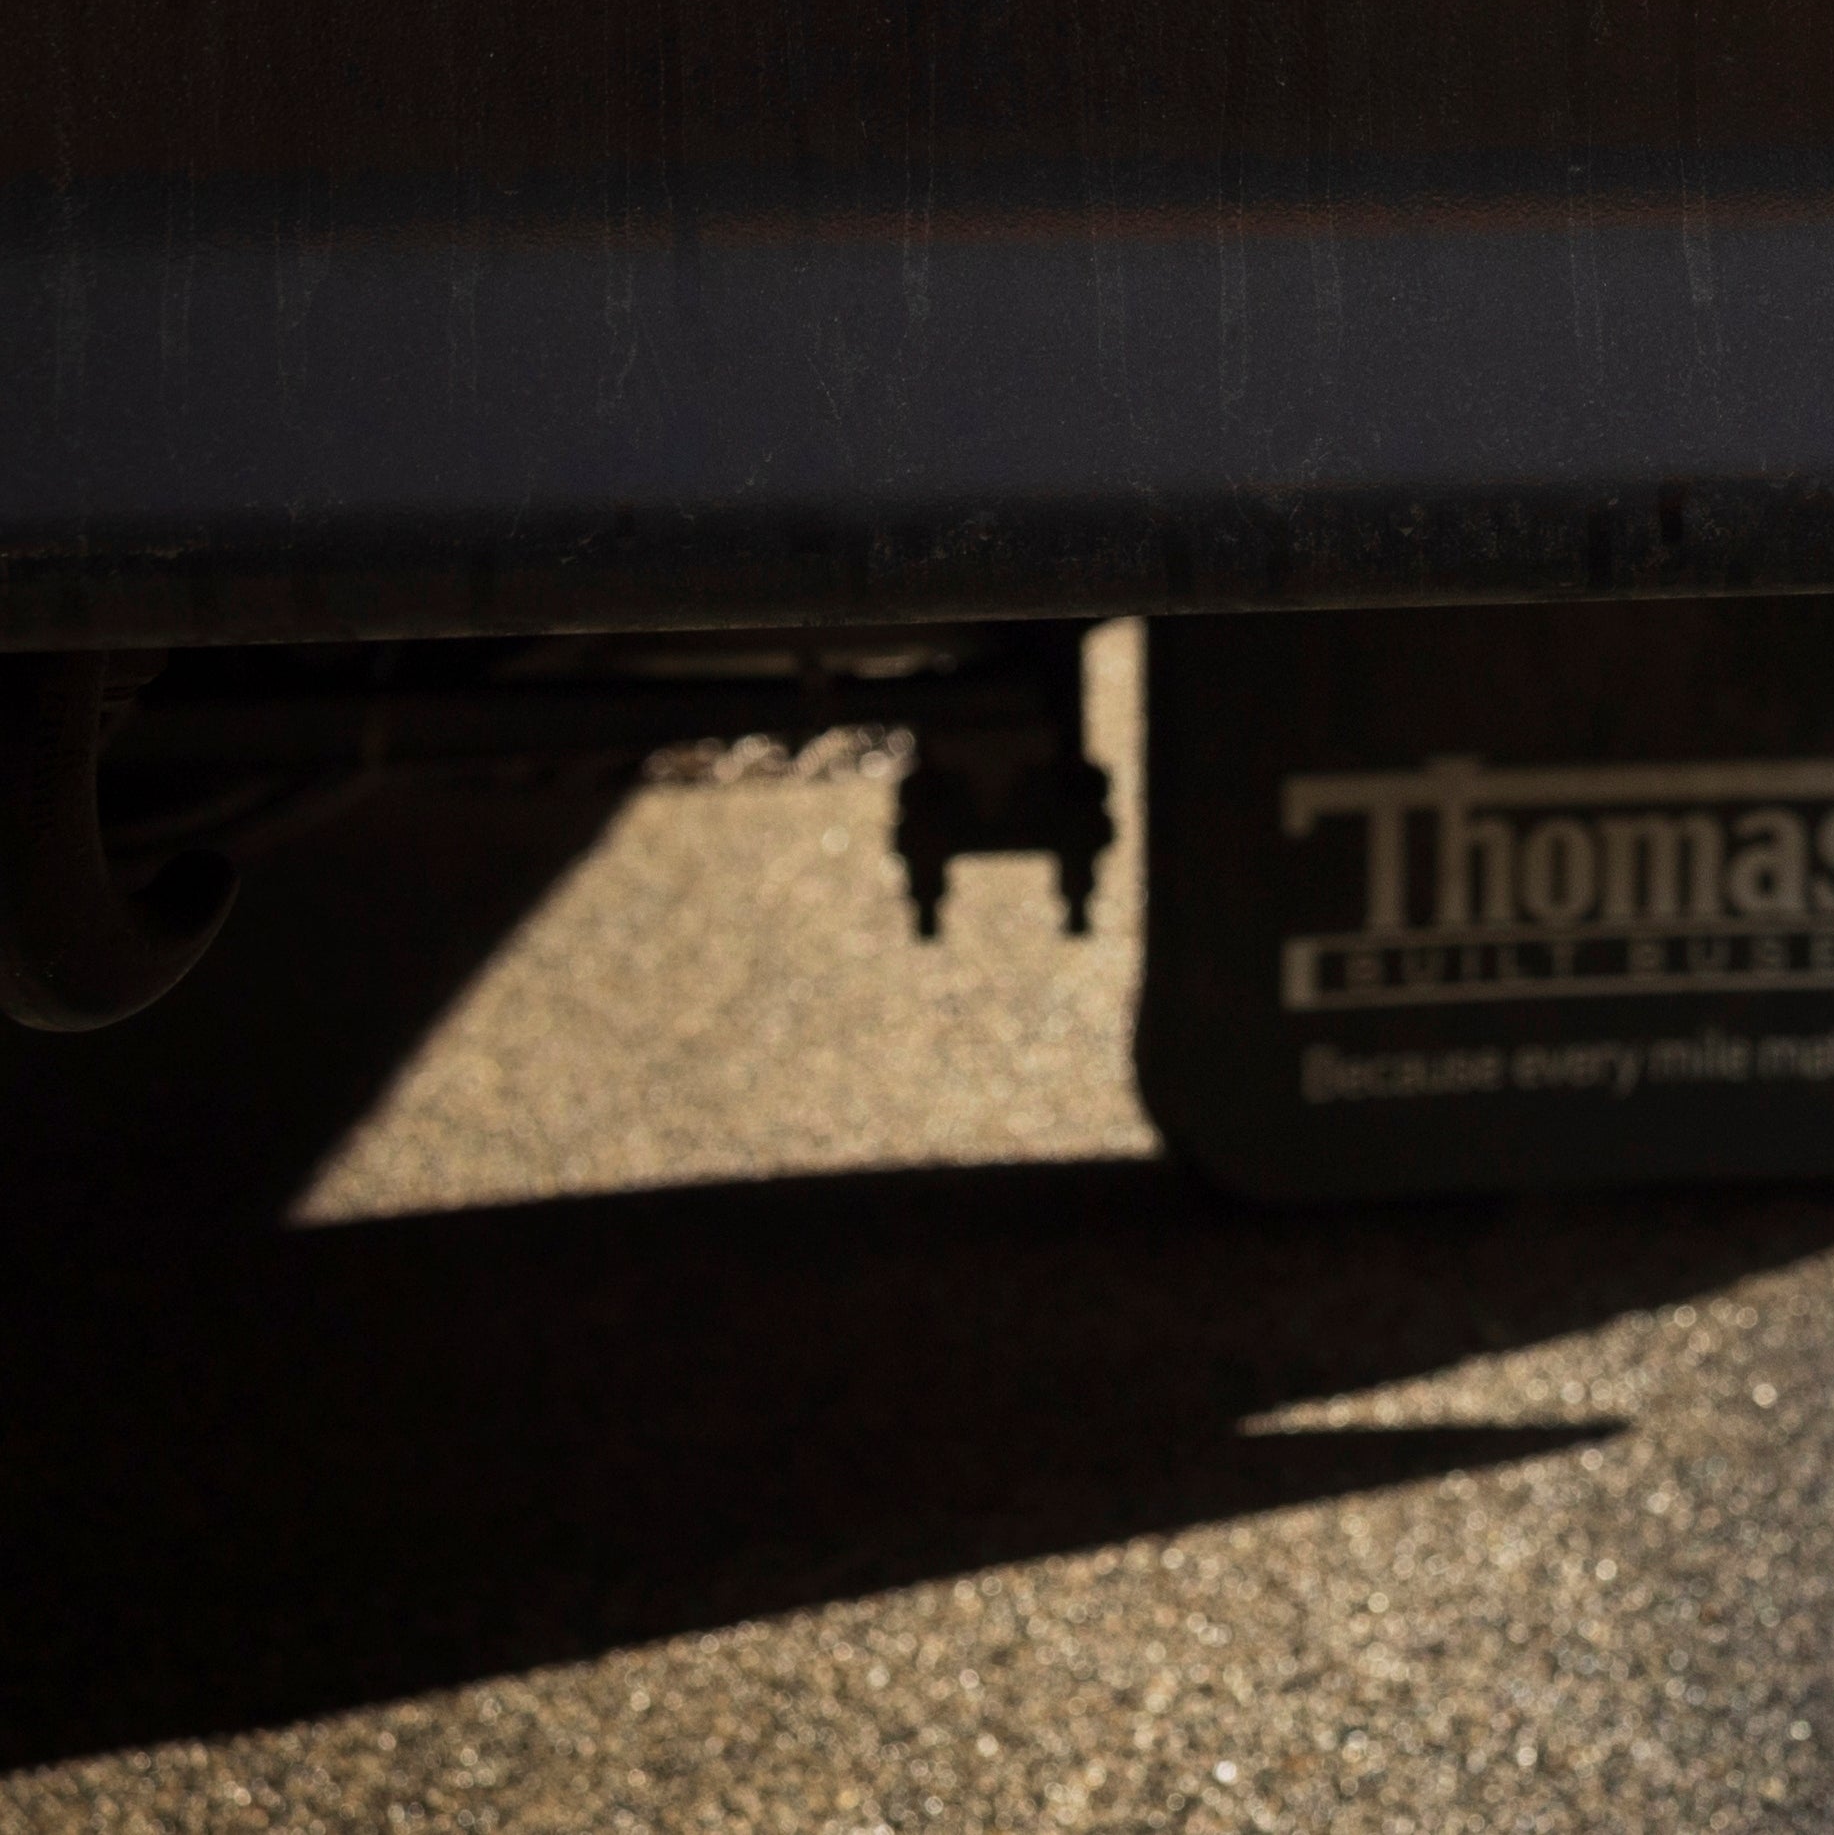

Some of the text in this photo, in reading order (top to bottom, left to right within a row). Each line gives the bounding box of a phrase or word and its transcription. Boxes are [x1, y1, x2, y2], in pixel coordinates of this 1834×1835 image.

[1342, 939, 1578, 989] BUILT
[1301, 1041, 1504, 1104] Because
[1511, 1039, 1640, 1100] every
[1648, 1023, 1751, 1082] mile
